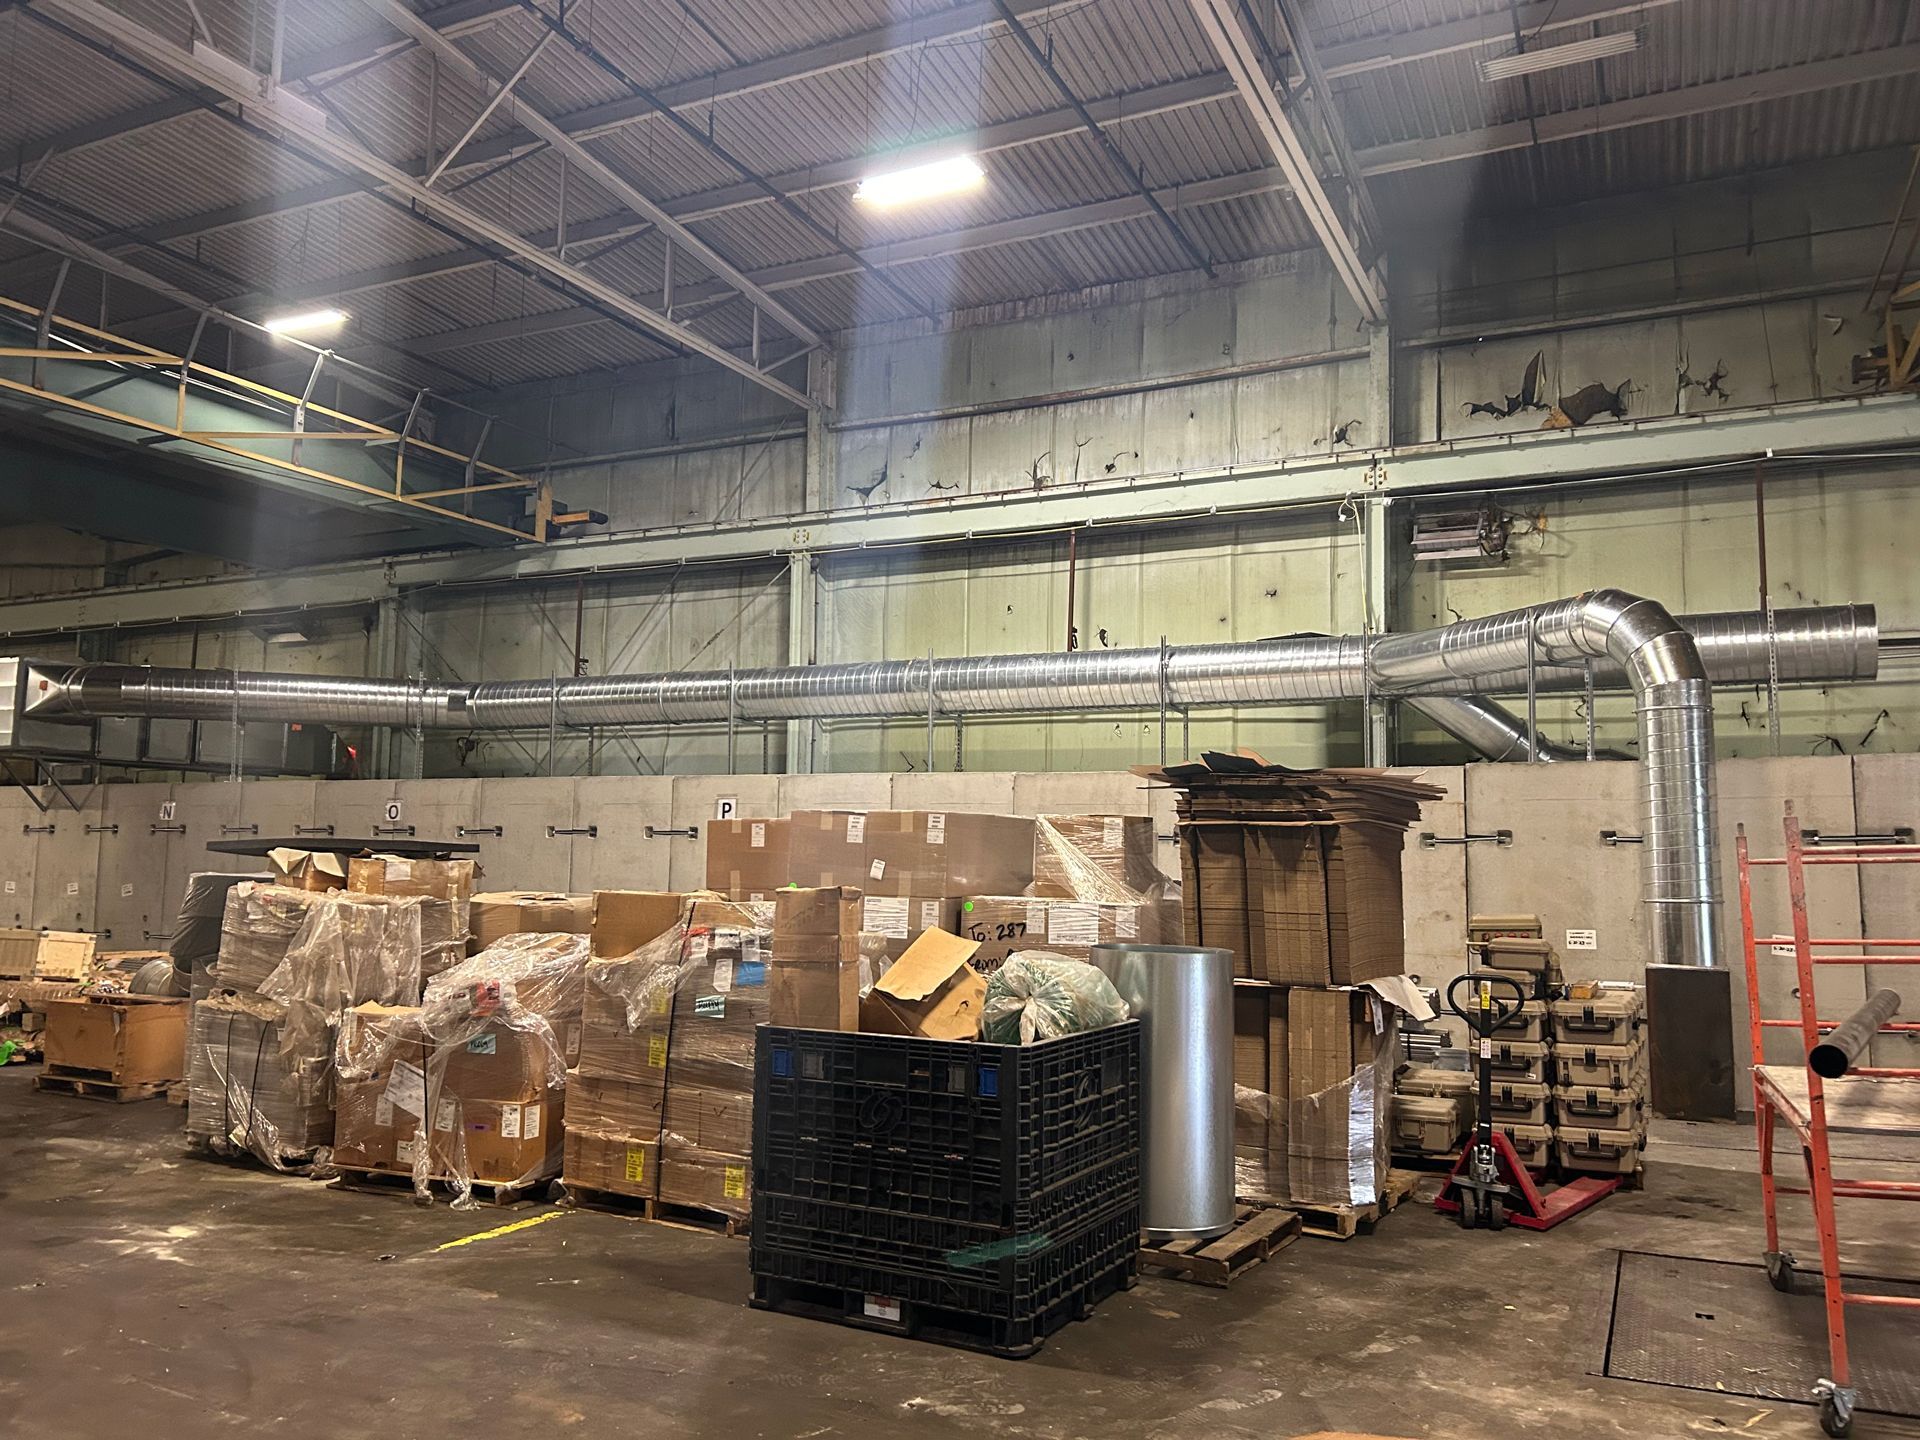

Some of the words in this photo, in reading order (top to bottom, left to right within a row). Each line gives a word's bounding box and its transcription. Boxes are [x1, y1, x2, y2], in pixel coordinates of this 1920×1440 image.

[163, 805, 172, 819] N
[722, 802, 732, 819] P
[967, 922, 992, 942] To:
[996, 922, 1027, 941] 287
